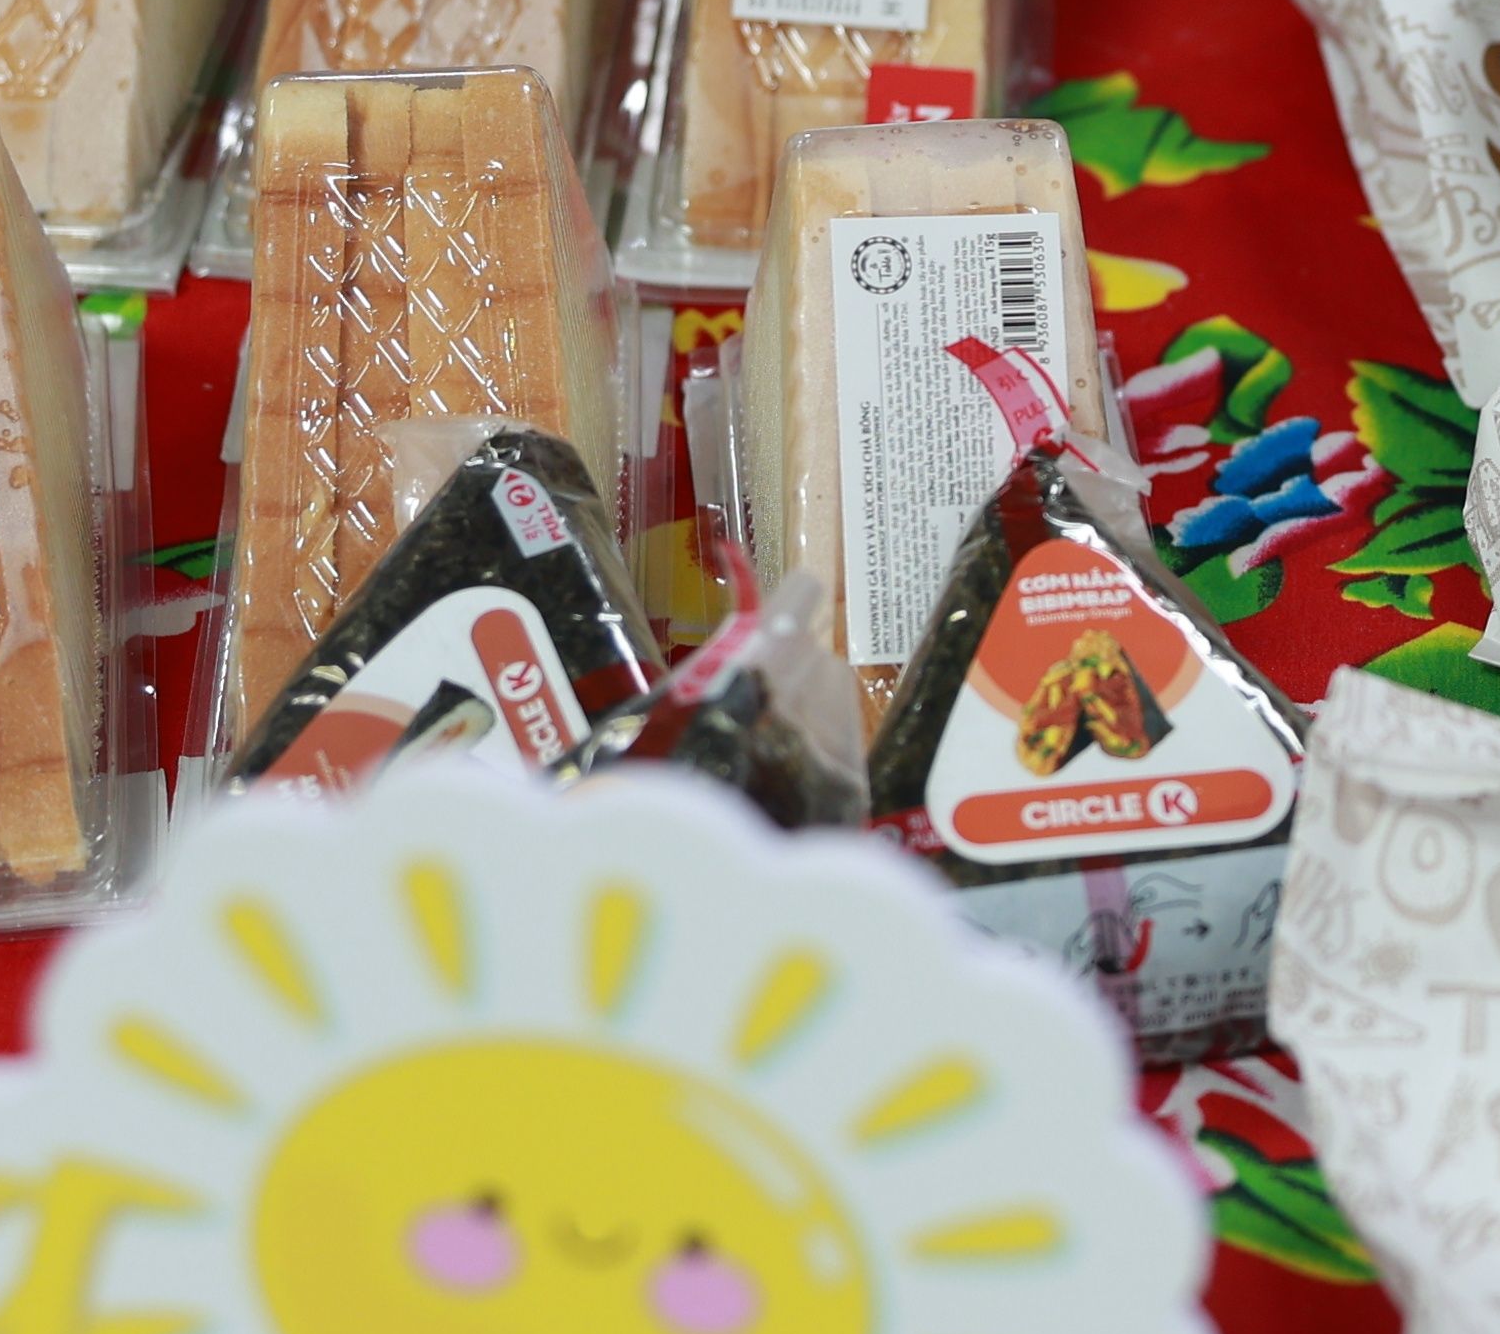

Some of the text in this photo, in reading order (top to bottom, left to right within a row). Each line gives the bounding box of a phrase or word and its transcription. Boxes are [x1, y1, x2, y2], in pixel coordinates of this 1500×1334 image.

[984, 233, 997, 260] 115g
[1033, 235, 1046, 287] 530630
[1036, 295, 1049, 346] 936087
[537, 503, 567, 542] PULL
[858, 401, 881, 654] SANDWICH GÀ CAY VÀ XÚC XÍCH CHÀ BÔNG
[1017, 572, 1072, 593] CƠM
[1020, 588, 1132, 615] BIBIMBAP
[518, 698, 564, 765] RCLE
[1021, 791, 1190, 829] CIRCLE K
